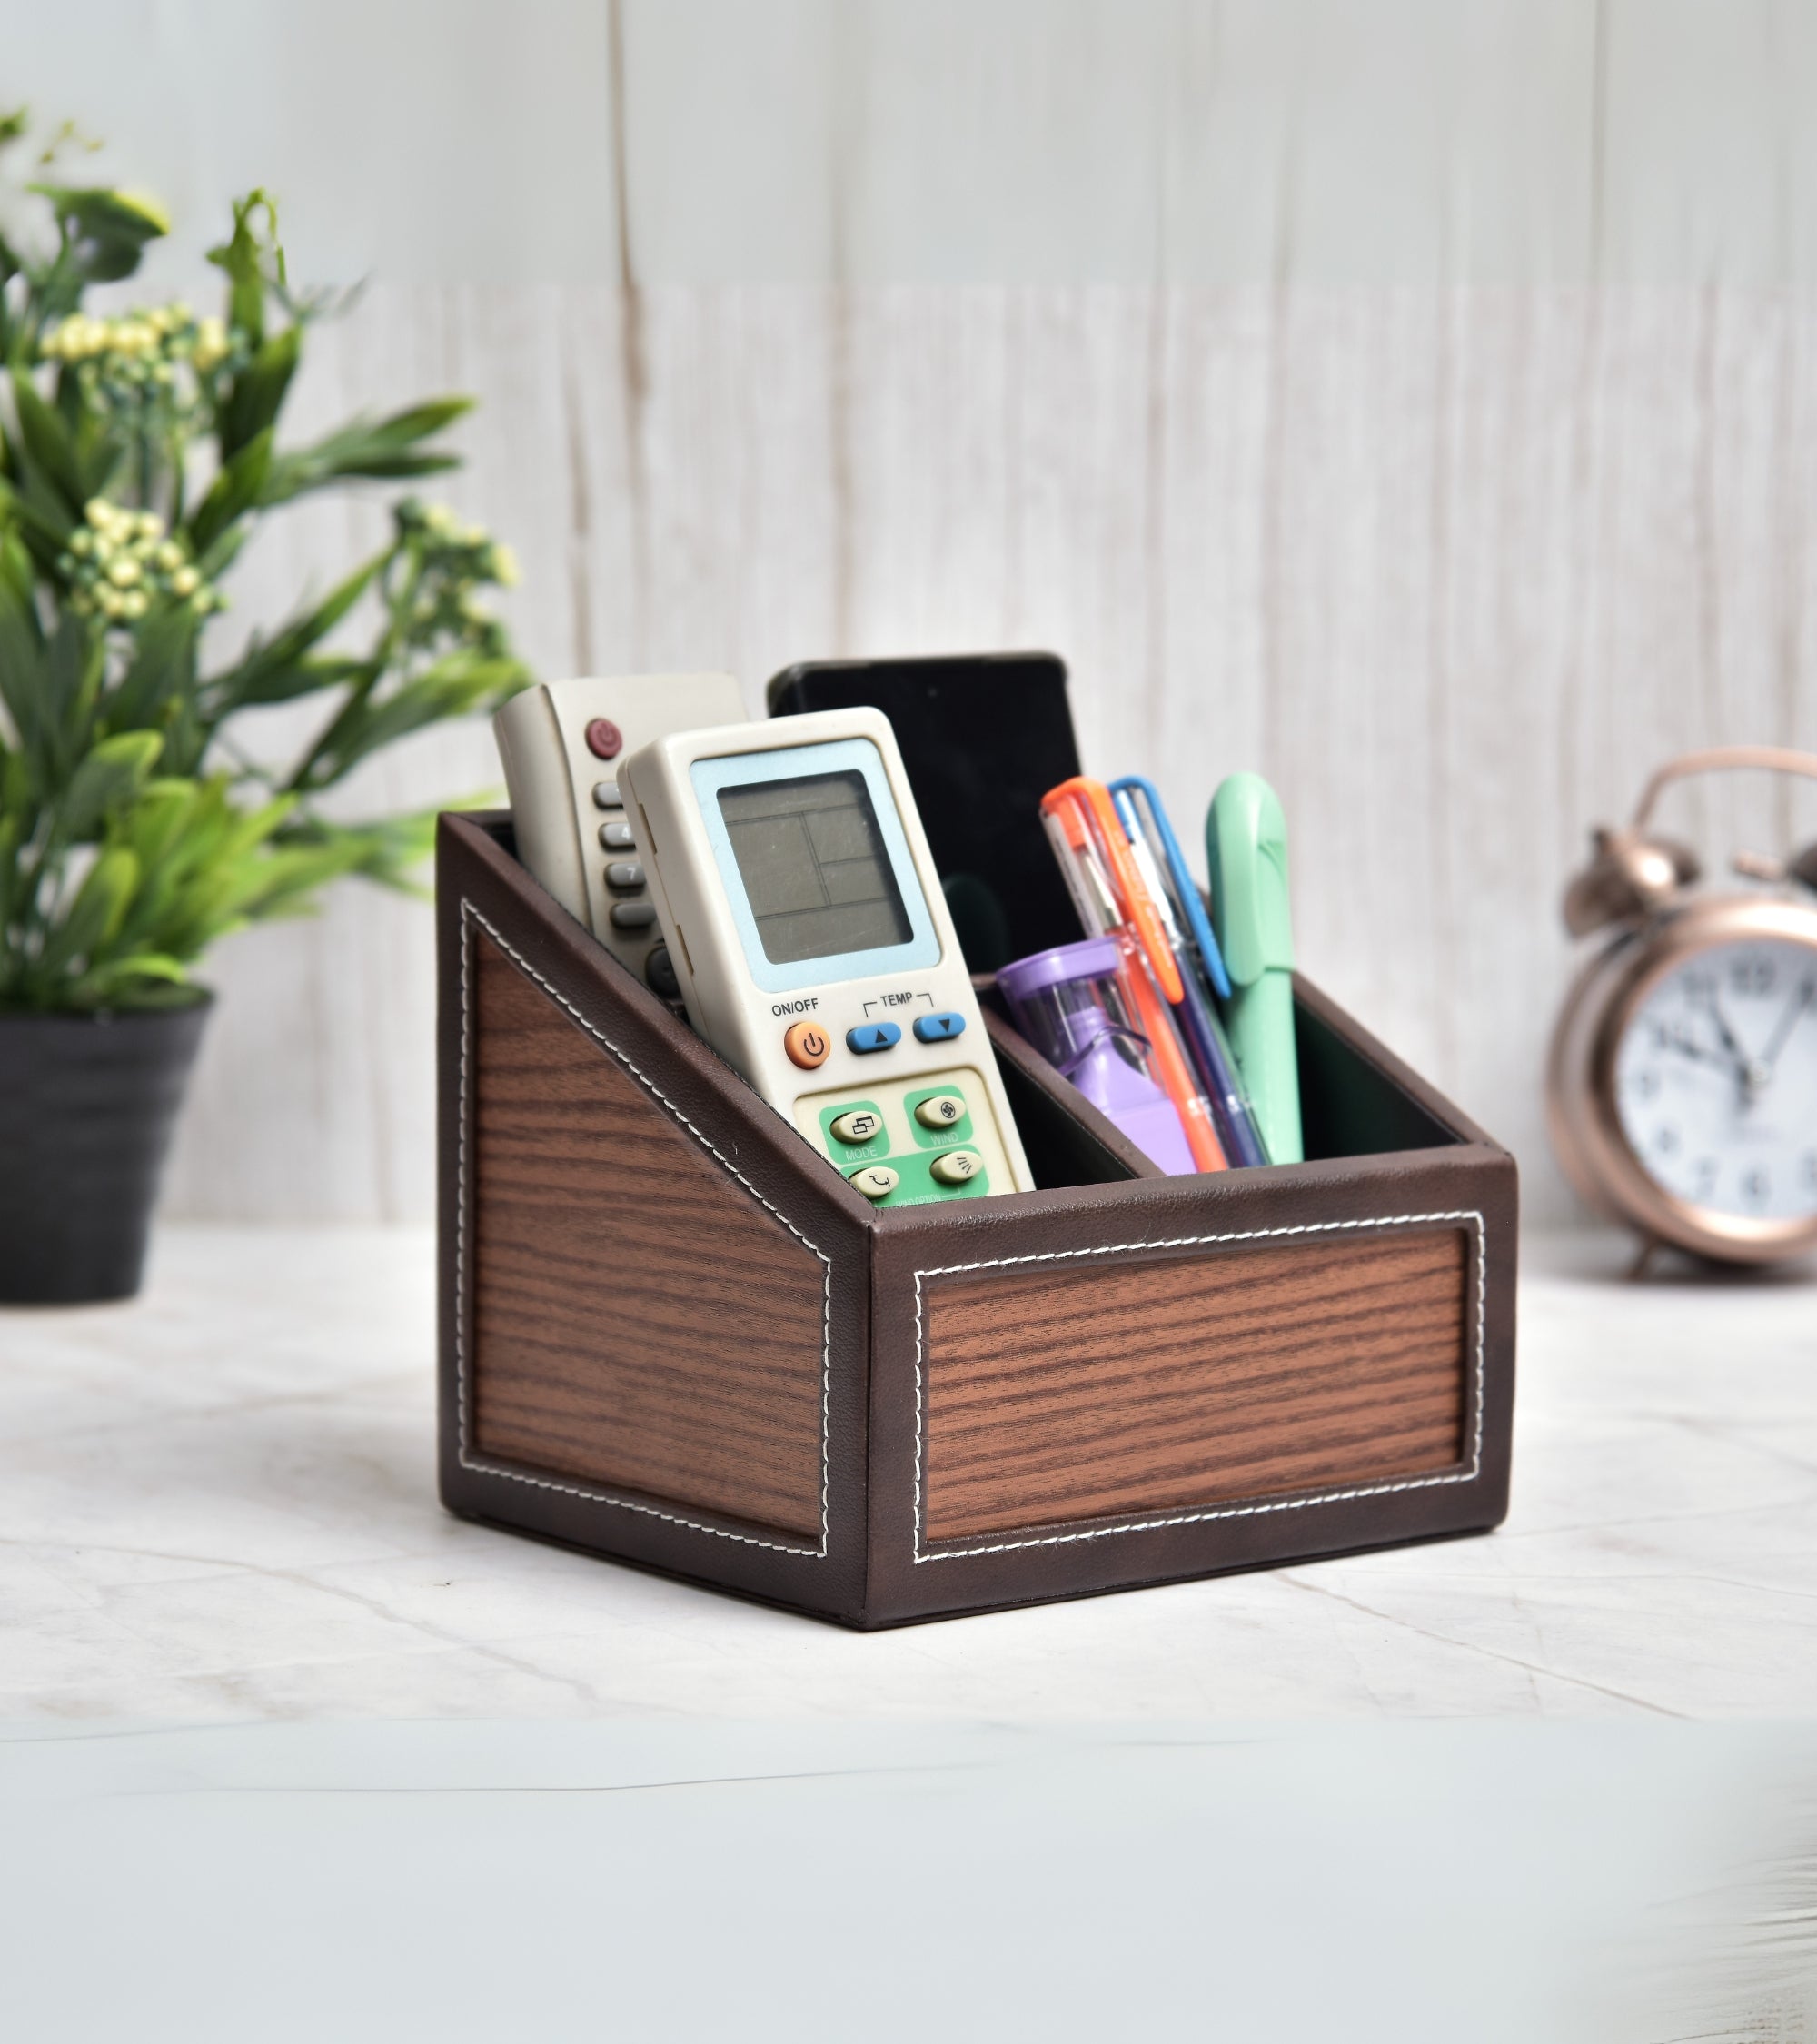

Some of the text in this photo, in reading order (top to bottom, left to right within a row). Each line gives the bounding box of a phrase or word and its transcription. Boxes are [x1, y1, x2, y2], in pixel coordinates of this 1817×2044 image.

[621, 826, 631, 840] 4
[626, 866, 637, 880] 7
[879, 991, 913, 1007] TEMP
[771, 997, 819, 1017] ON/OFF
[931, 1132, 959, 1146] WIND
[845, 1145, 878, 1161] MODE
